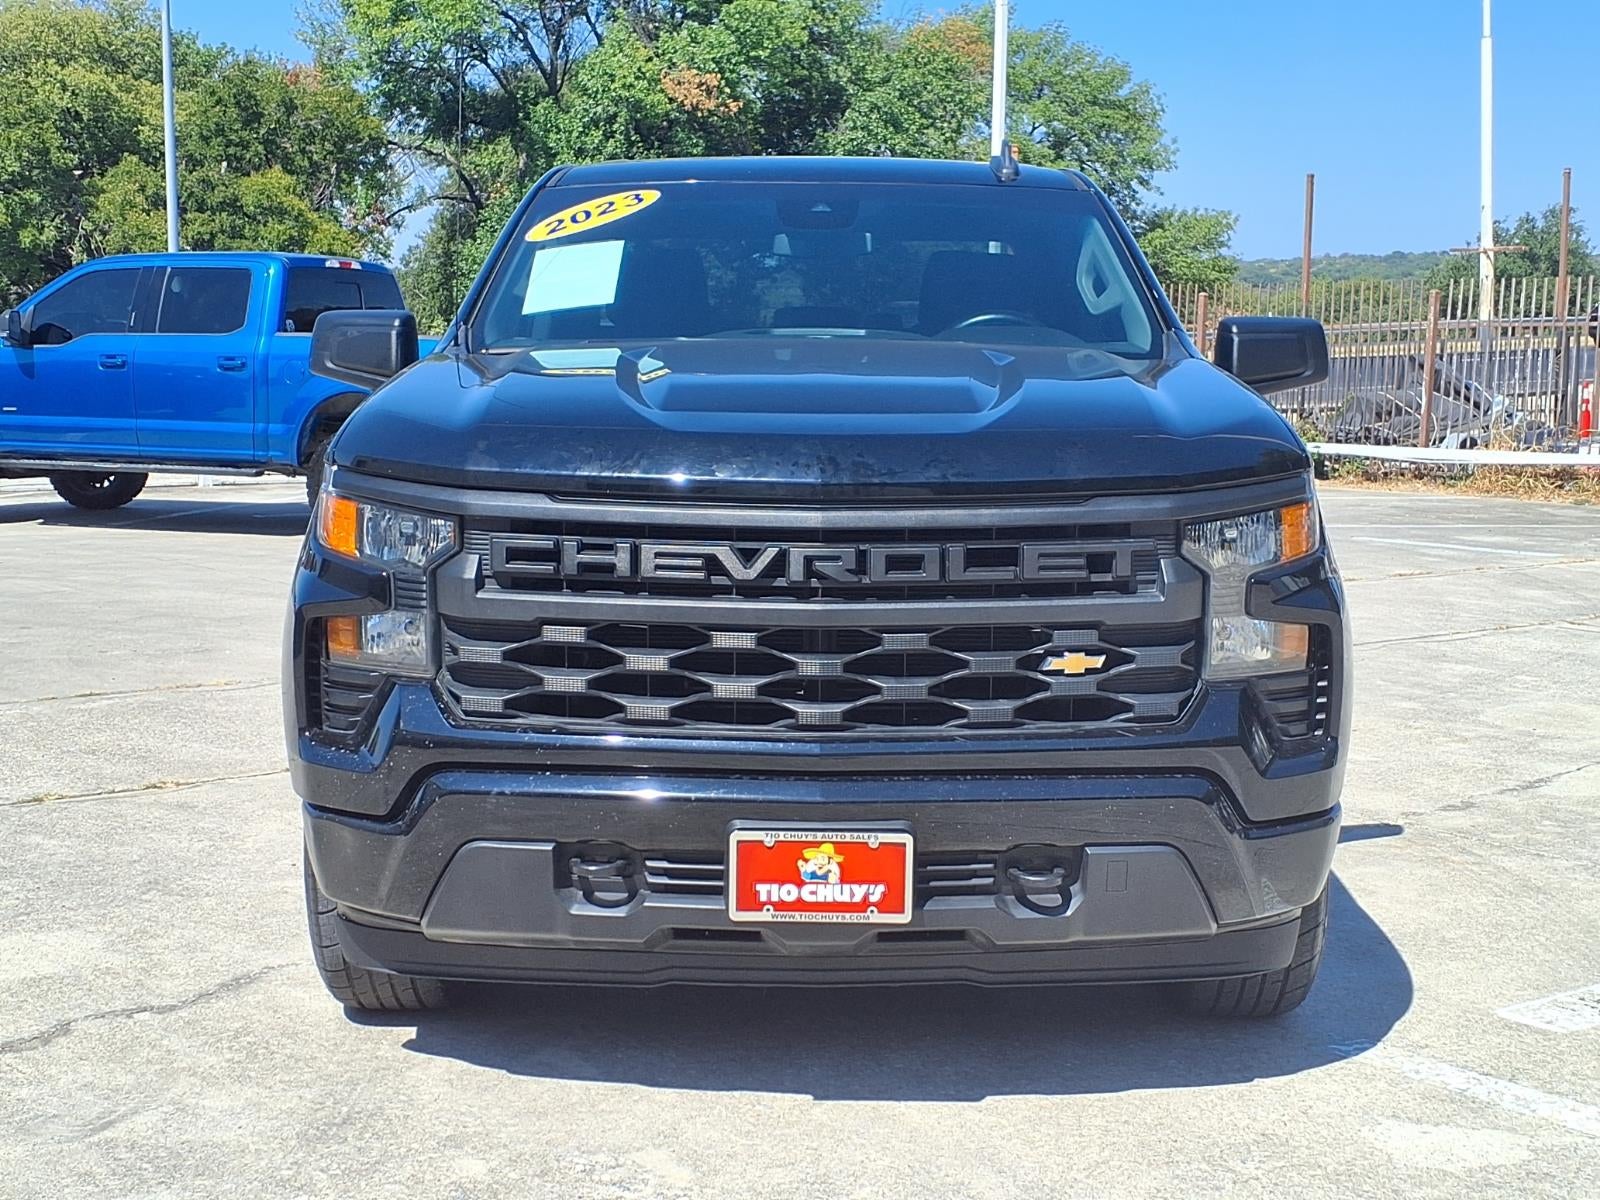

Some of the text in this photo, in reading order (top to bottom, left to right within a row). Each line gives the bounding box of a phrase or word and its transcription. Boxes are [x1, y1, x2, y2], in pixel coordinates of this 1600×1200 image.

[545, 192, 645, 236] 2023
[491, 536, 1156, 585] CHEVROLET
[764, 832, 879, 841] TIO CHUY'S AUTO SALES
[755, 883, 887, 903] TIO CHUY'S
[770, 912, 871, 922] WWW.TIOCHUYS.COM
